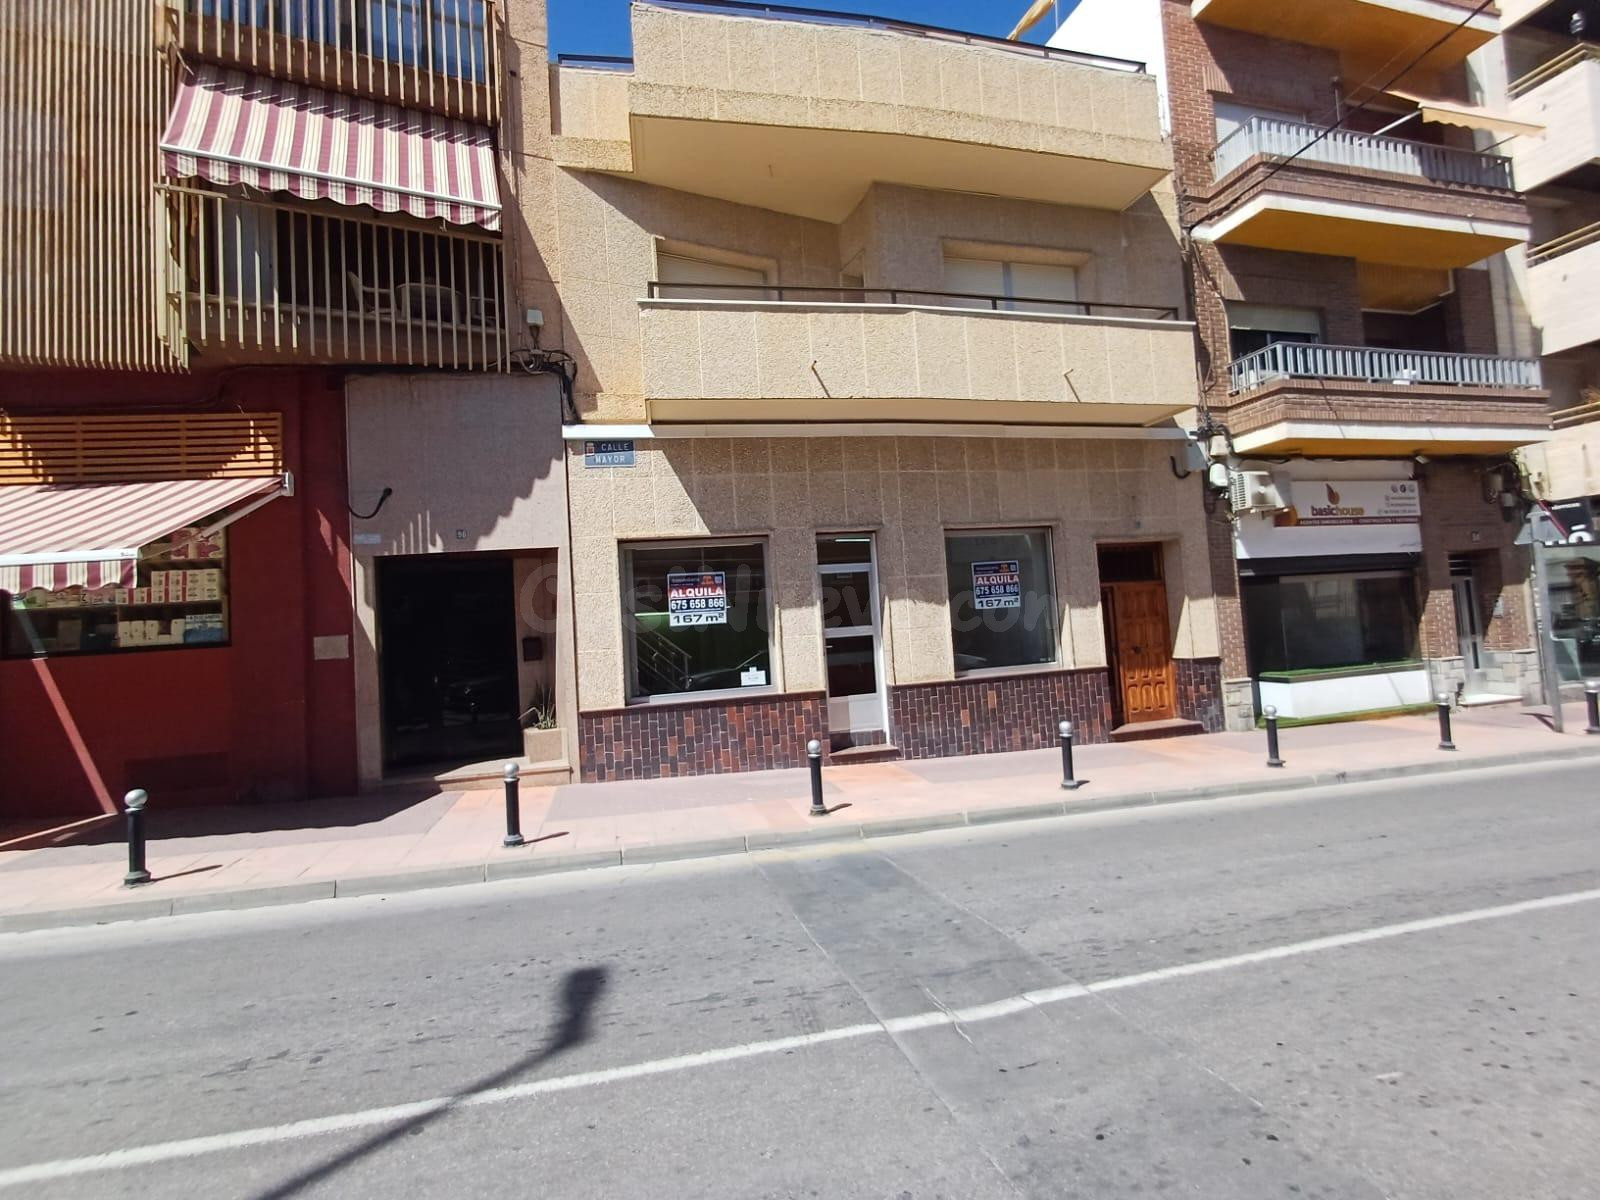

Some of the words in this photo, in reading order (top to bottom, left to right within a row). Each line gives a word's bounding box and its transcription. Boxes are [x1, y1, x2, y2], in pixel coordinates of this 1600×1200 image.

[601, 443, 630, 451] CALLE
[595, 455, 625, 464] MAYOR
[977, 575, 1019, 585] ALQUILA
[671, 587, 723, 598] ALQUILA
[976, 586, 990, 595] 675
[671, 600, 687, 610] 675
[690, 599, 706, 609] 658
[708, 598, 724, 608] 866
[978, 598, 1002, 608] 167
[673, 614, 702, 624] 167
